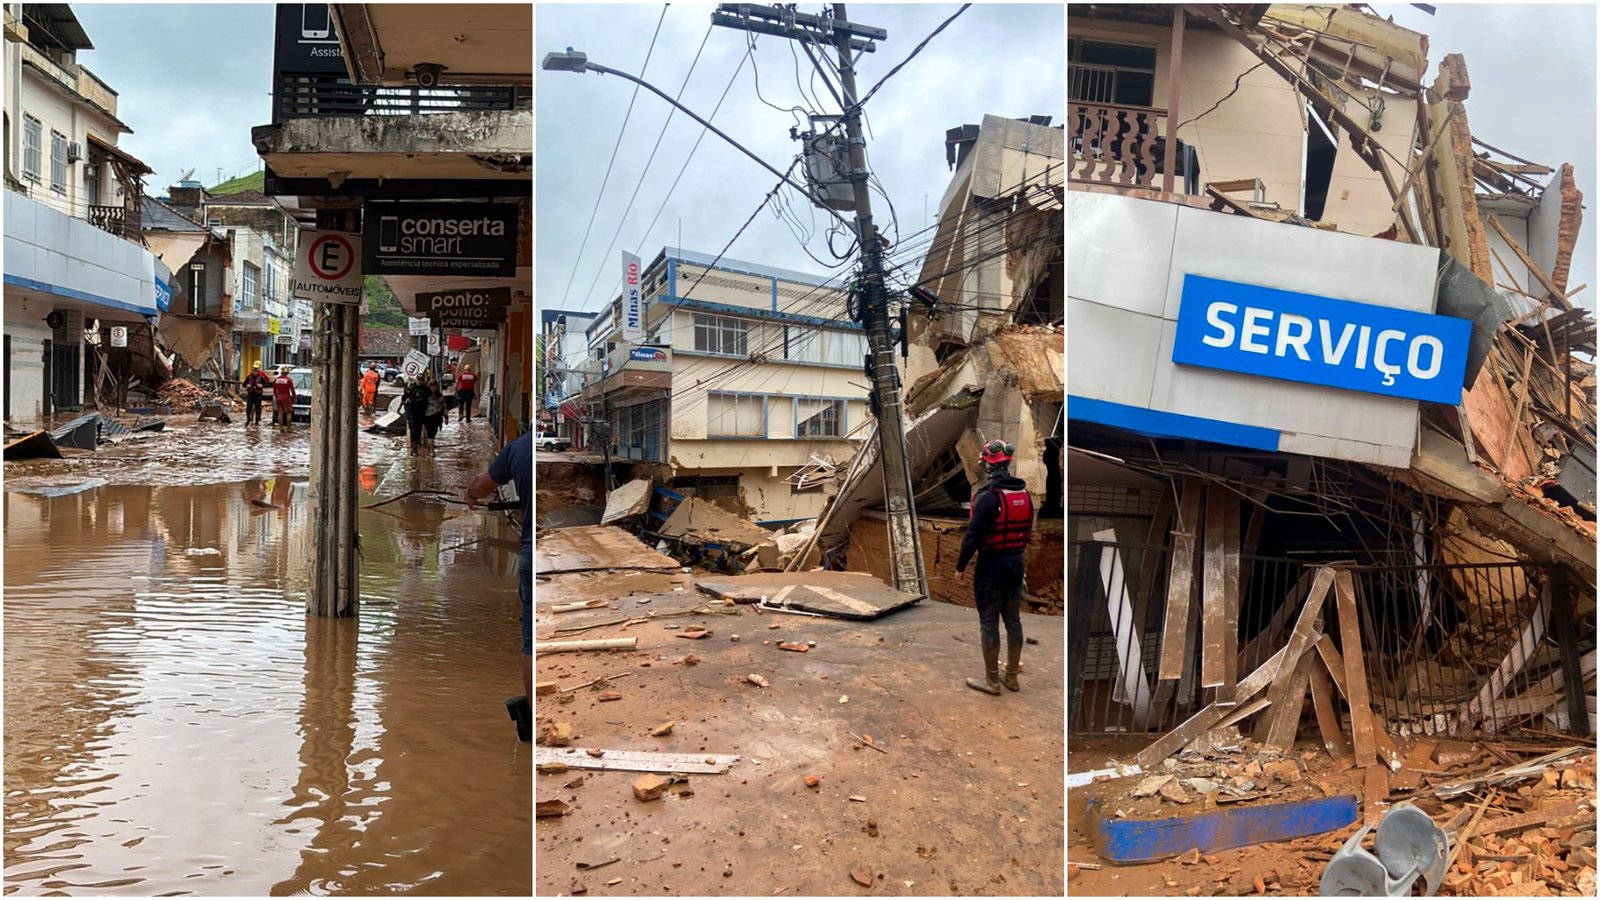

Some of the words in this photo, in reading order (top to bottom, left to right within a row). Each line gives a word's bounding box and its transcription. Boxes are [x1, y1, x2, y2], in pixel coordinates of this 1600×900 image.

[401, 217, 504, 236] conserta
[400, 236, 462, 254] smart
[321, 242, 340, 271] E
[380, 259, 420, 267] Assistência
[421, 259, 449, 268] técnica
[450, 260, 500, 269] especializada
[627, 263, 638, 285] Rio
[296, 282, 360, 297] AUTOMÓVEIS
[627, 289, 638, 328] Minas
[1201, 301, 1444, 386] SERVIÇO
